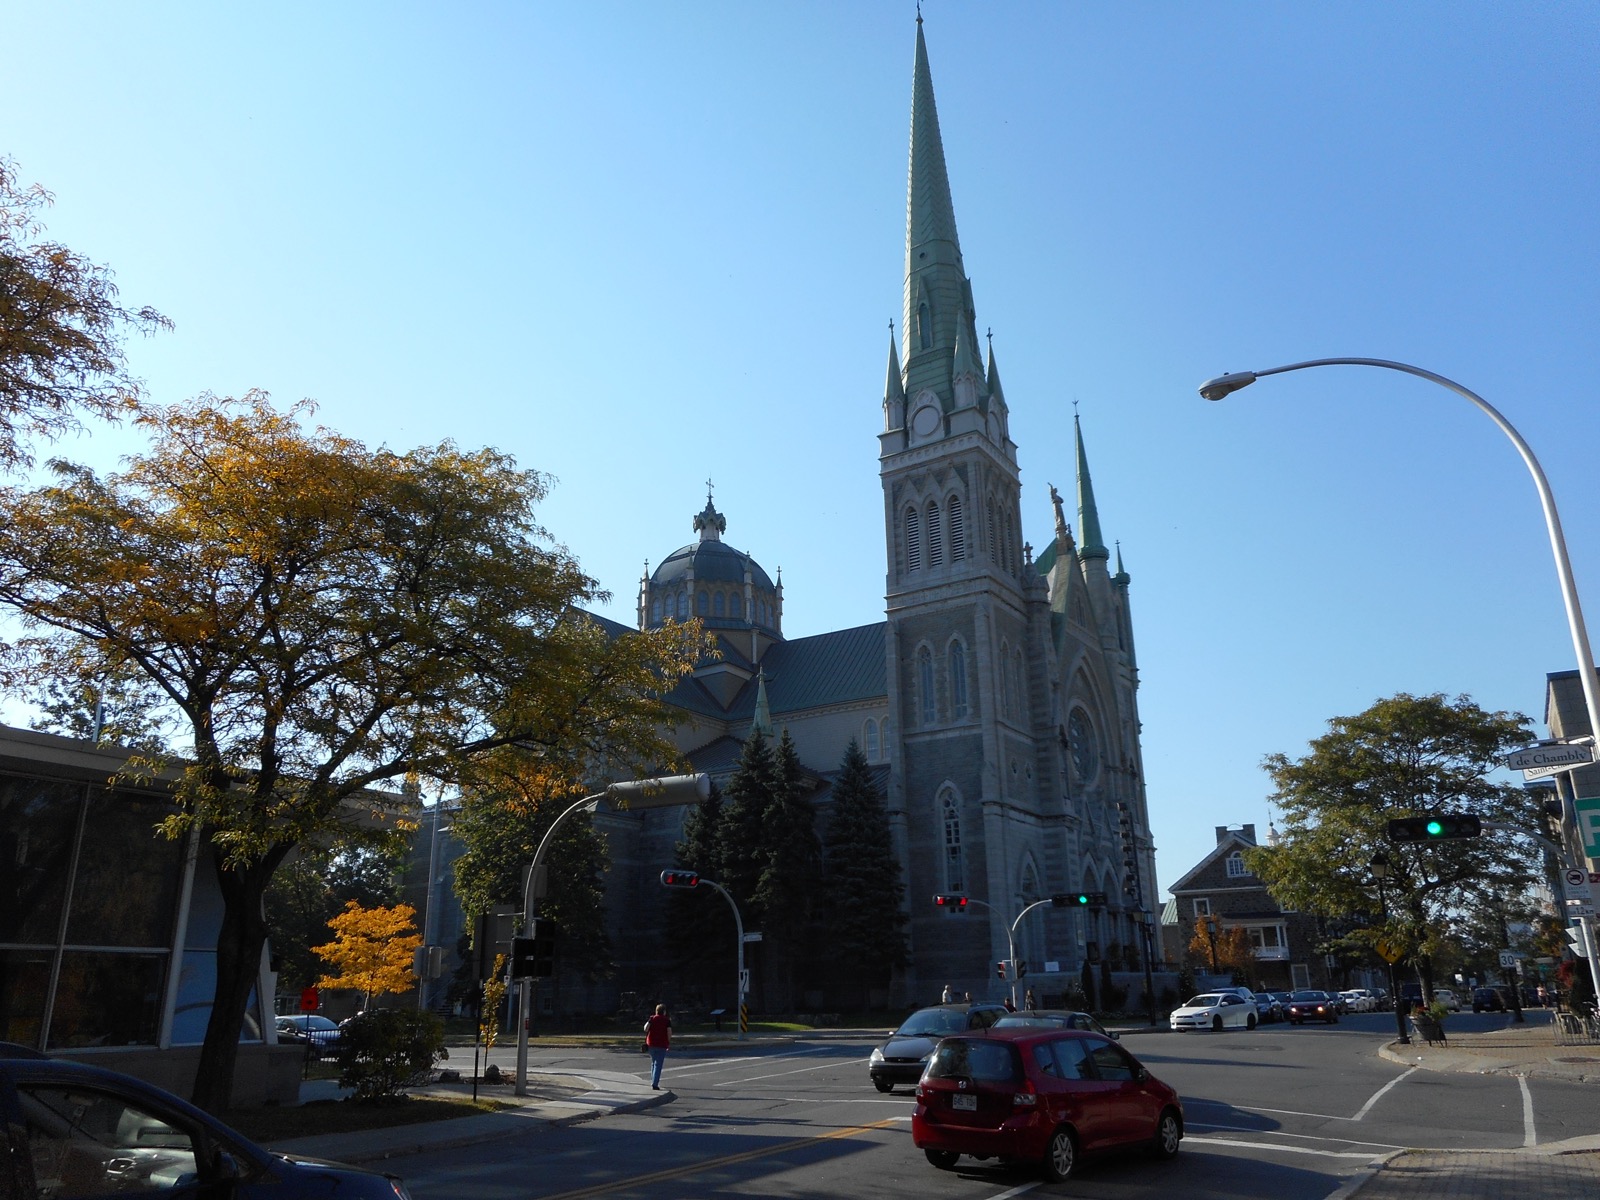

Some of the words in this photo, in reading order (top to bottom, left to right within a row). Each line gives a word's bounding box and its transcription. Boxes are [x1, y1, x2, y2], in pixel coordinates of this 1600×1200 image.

[1516, 756, 1530, 766] de
[1533, 750, 1586, 764] Chambly
[1500, 955, 1514, 966] 30
